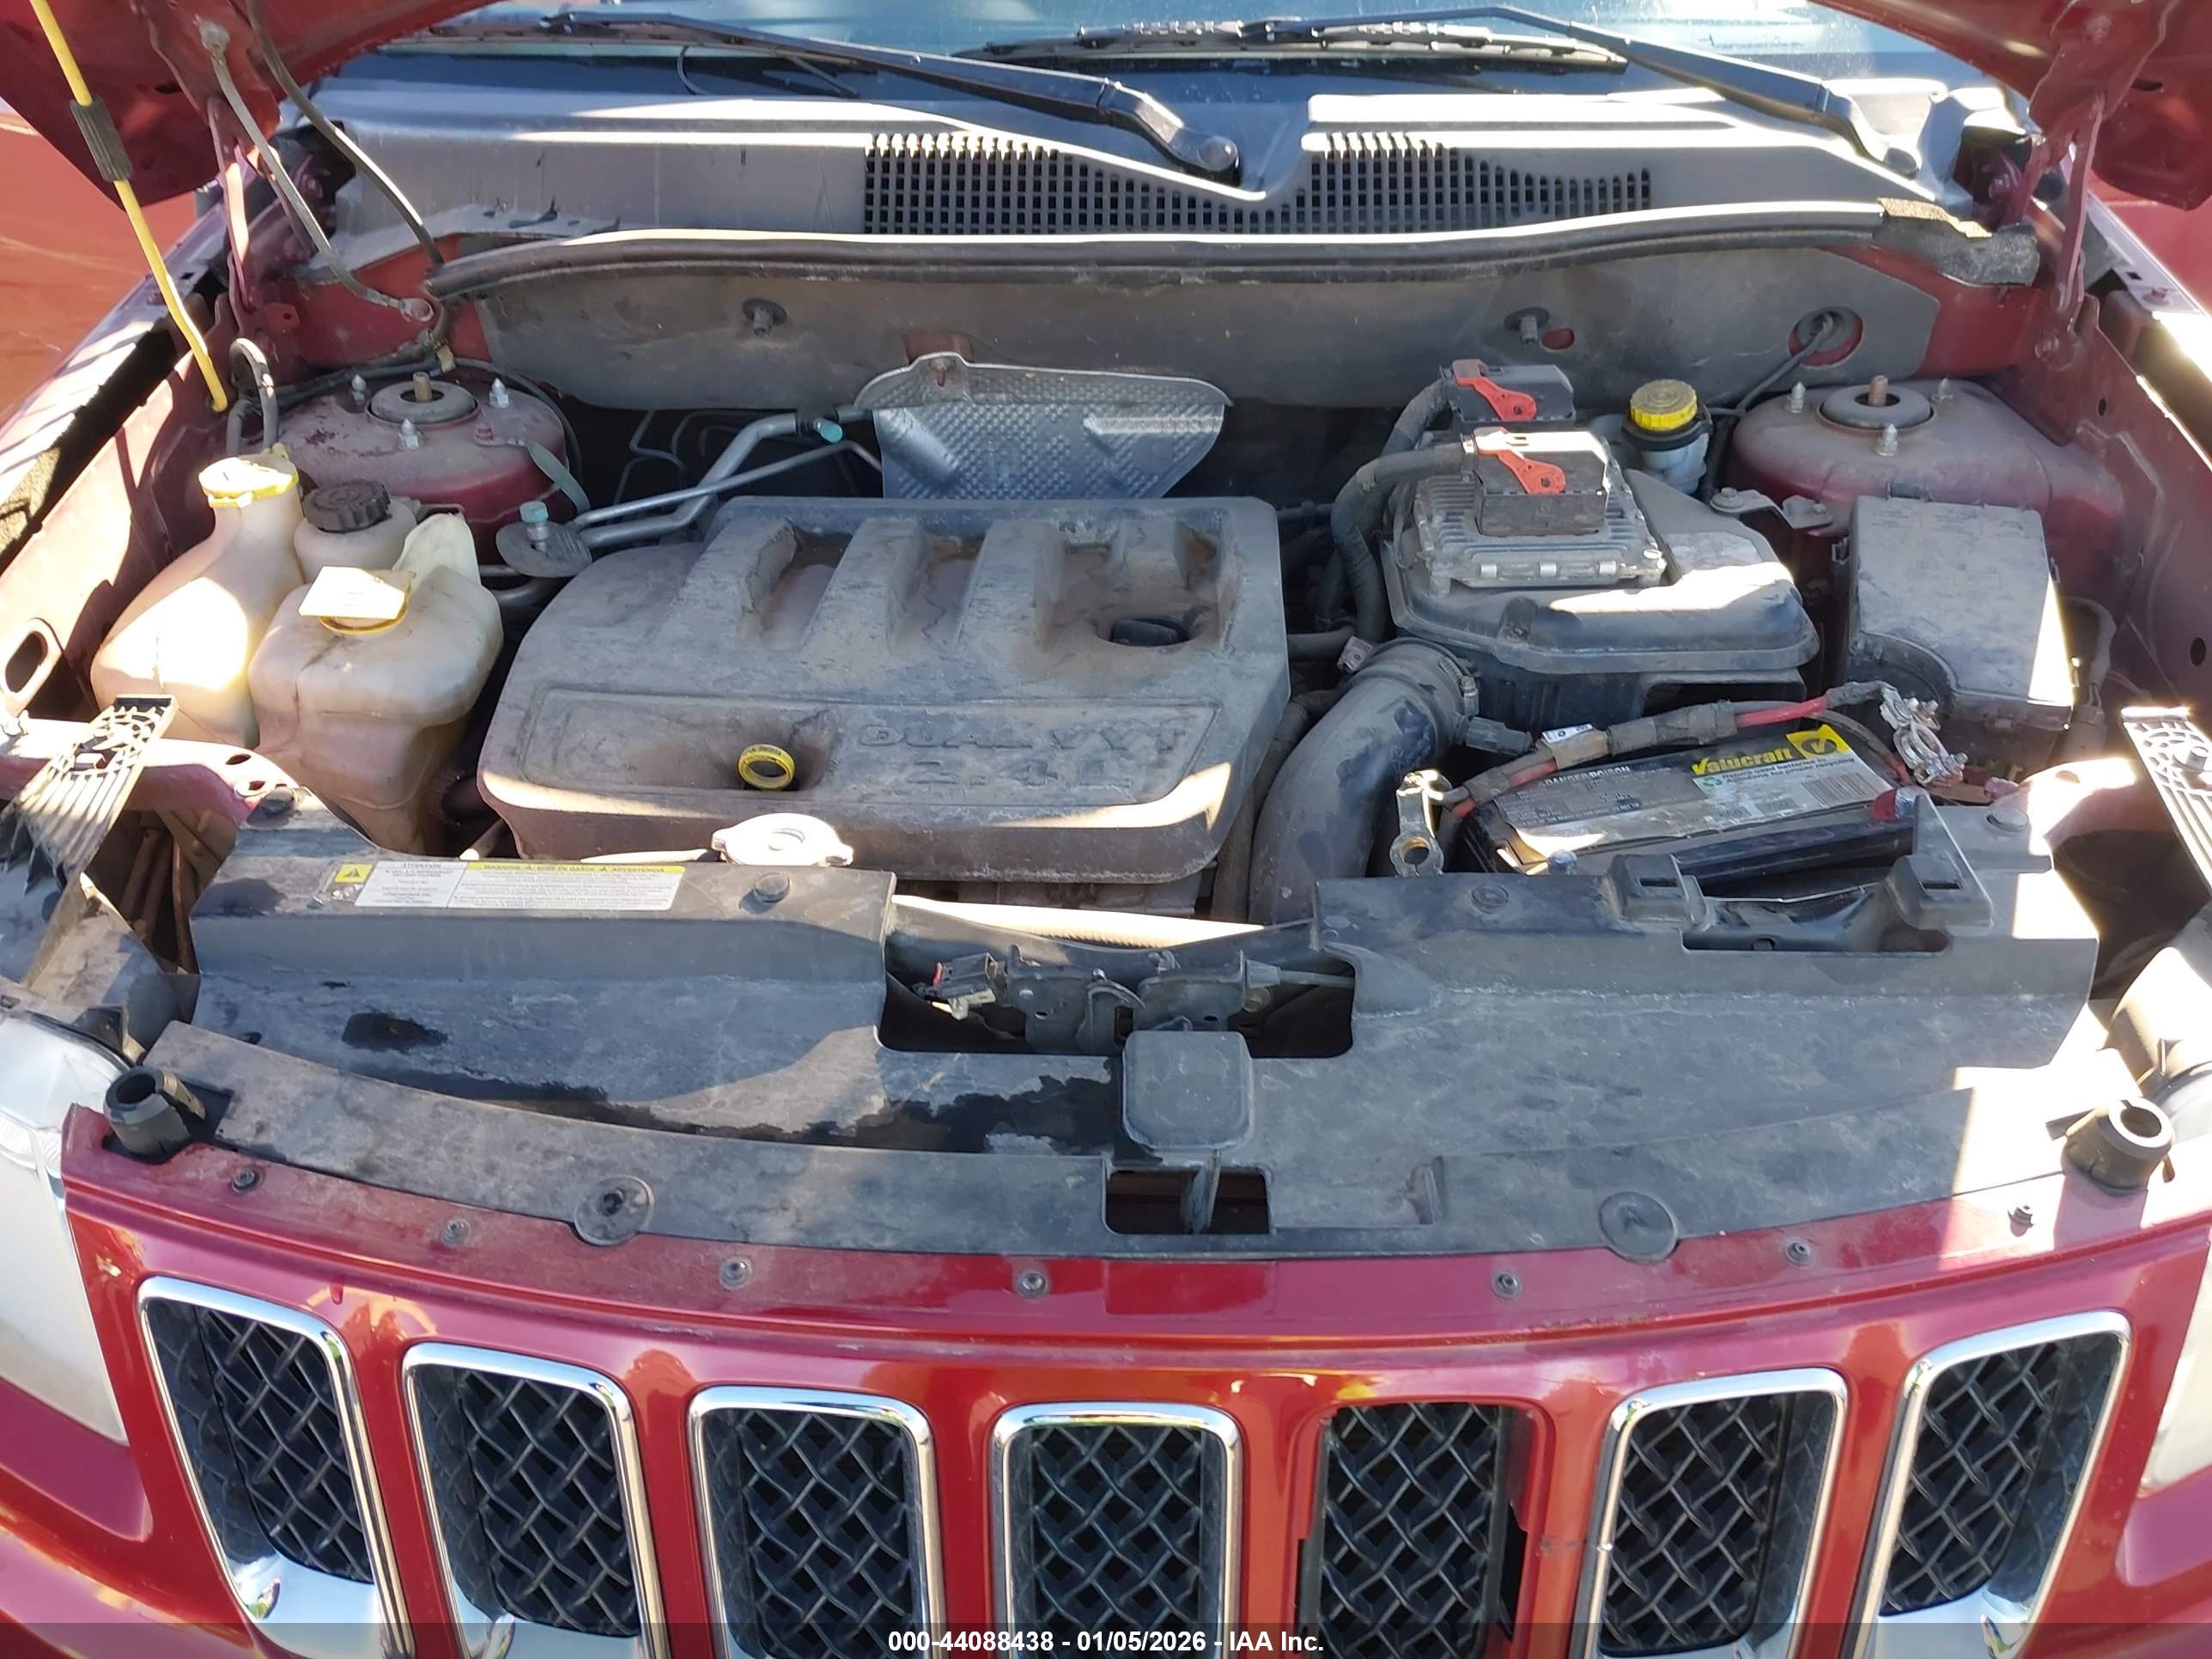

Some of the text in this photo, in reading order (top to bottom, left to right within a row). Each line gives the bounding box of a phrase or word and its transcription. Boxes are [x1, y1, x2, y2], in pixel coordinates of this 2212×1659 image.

[1692, 746, 1793, 775] Valucraft
[1754, 764, 1776, 776] used
[1777, 760, 1817, 772] batteries
